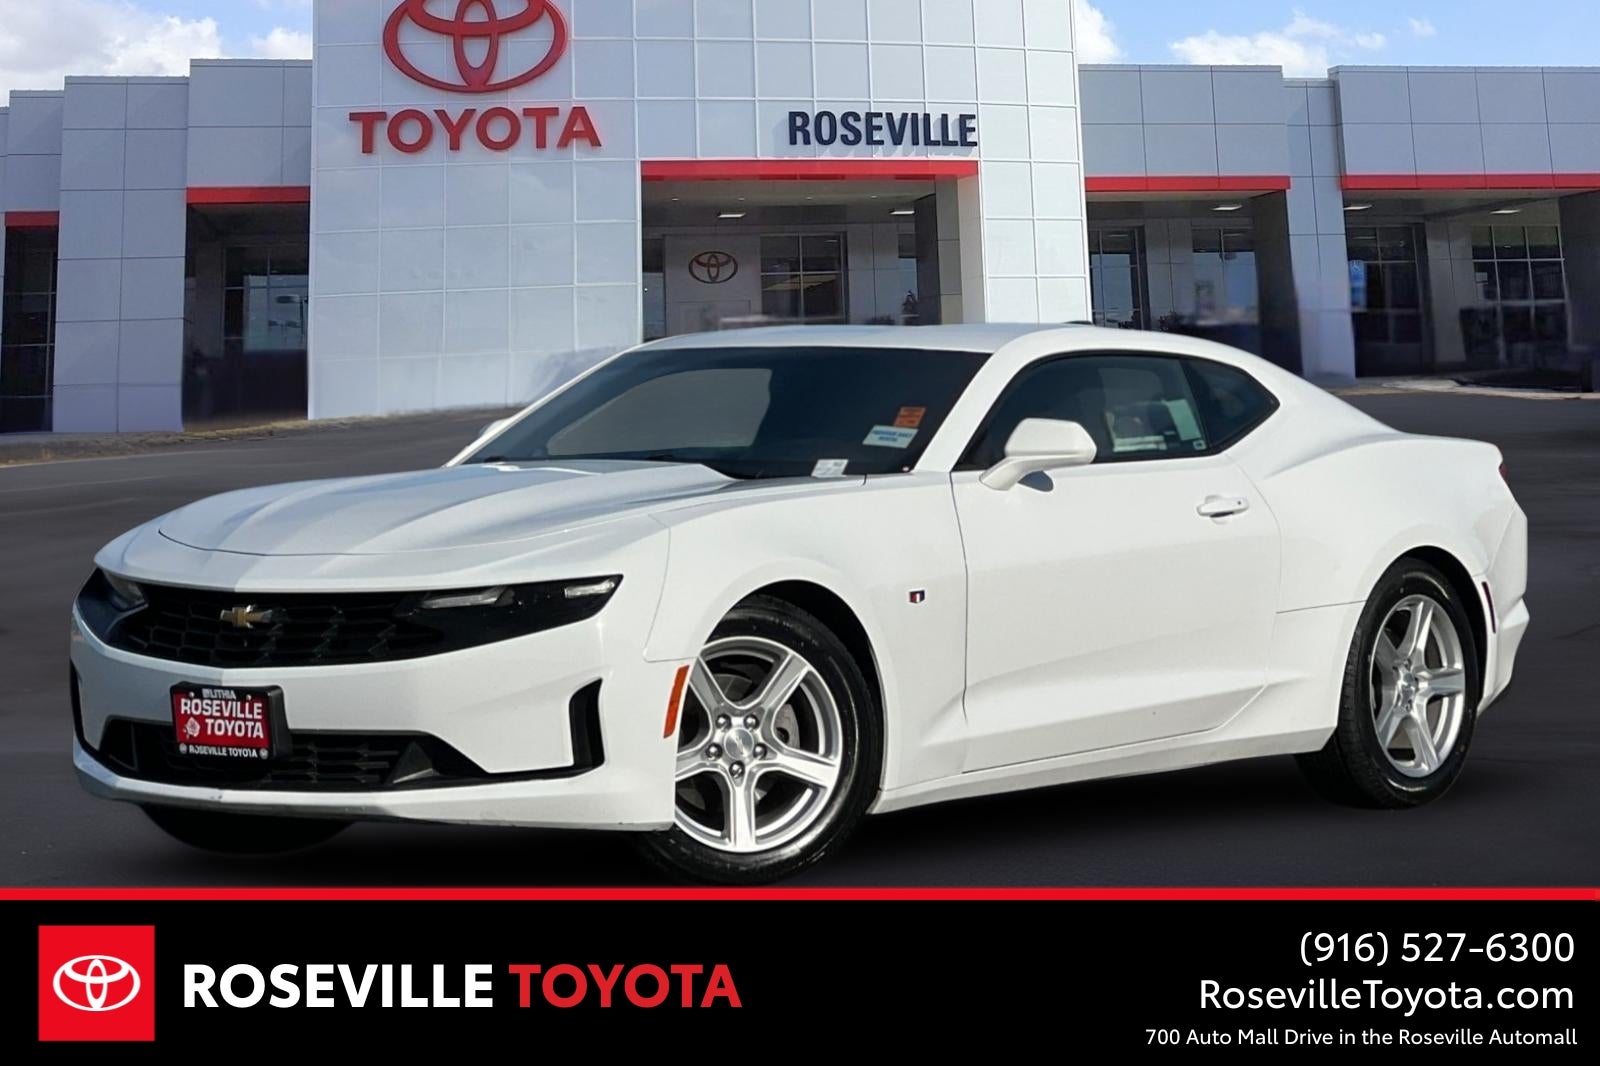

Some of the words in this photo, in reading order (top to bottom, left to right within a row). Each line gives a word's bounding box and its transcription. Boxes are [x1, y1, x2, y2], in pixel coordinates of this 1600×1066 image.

[349, 106, 602, 154] TOYOTA
[788, 110, 979, 148] ROSEVILLE
[180, 698, 263, 719] ROSEVILLE
[205, 718, 264, 739] TOYOTA
[189, 744, 228, 756] ROSEVILLE
[229, 747, 258, 758] TOYOTA
